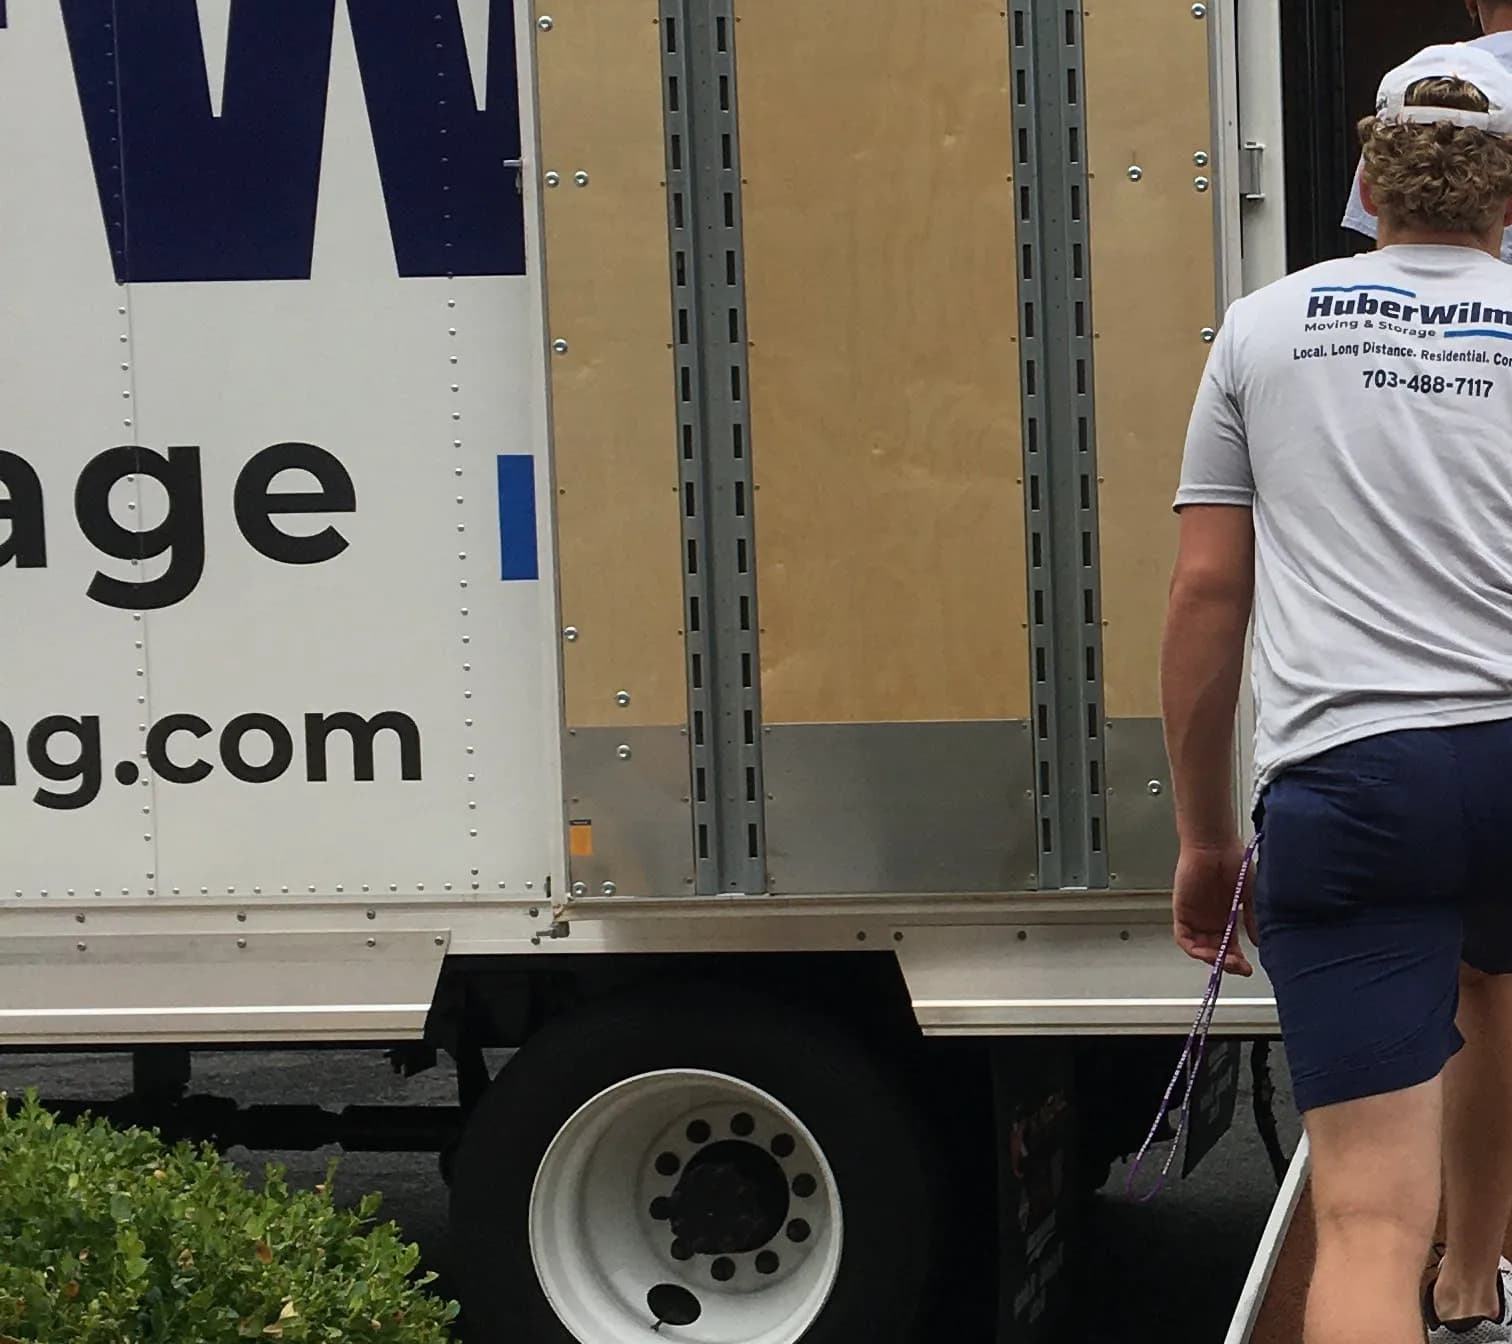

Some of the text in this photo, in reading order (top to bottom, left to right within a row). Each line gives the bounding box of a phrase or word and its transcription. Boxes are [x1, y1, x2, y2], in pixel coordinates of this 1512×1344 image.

[1304, 320, 1437, 338] Moving & Storage
[1293, 345, 1328, 360] Local.
[1331, 343, 1359, 356] Long
[1363, 342, 1417, 357] Distance.
[1421, 349, 1490, 363] Residential.
[1362, 369, 1494, 398] 703-488-7117
[0, 711, 422, 810] g.com
